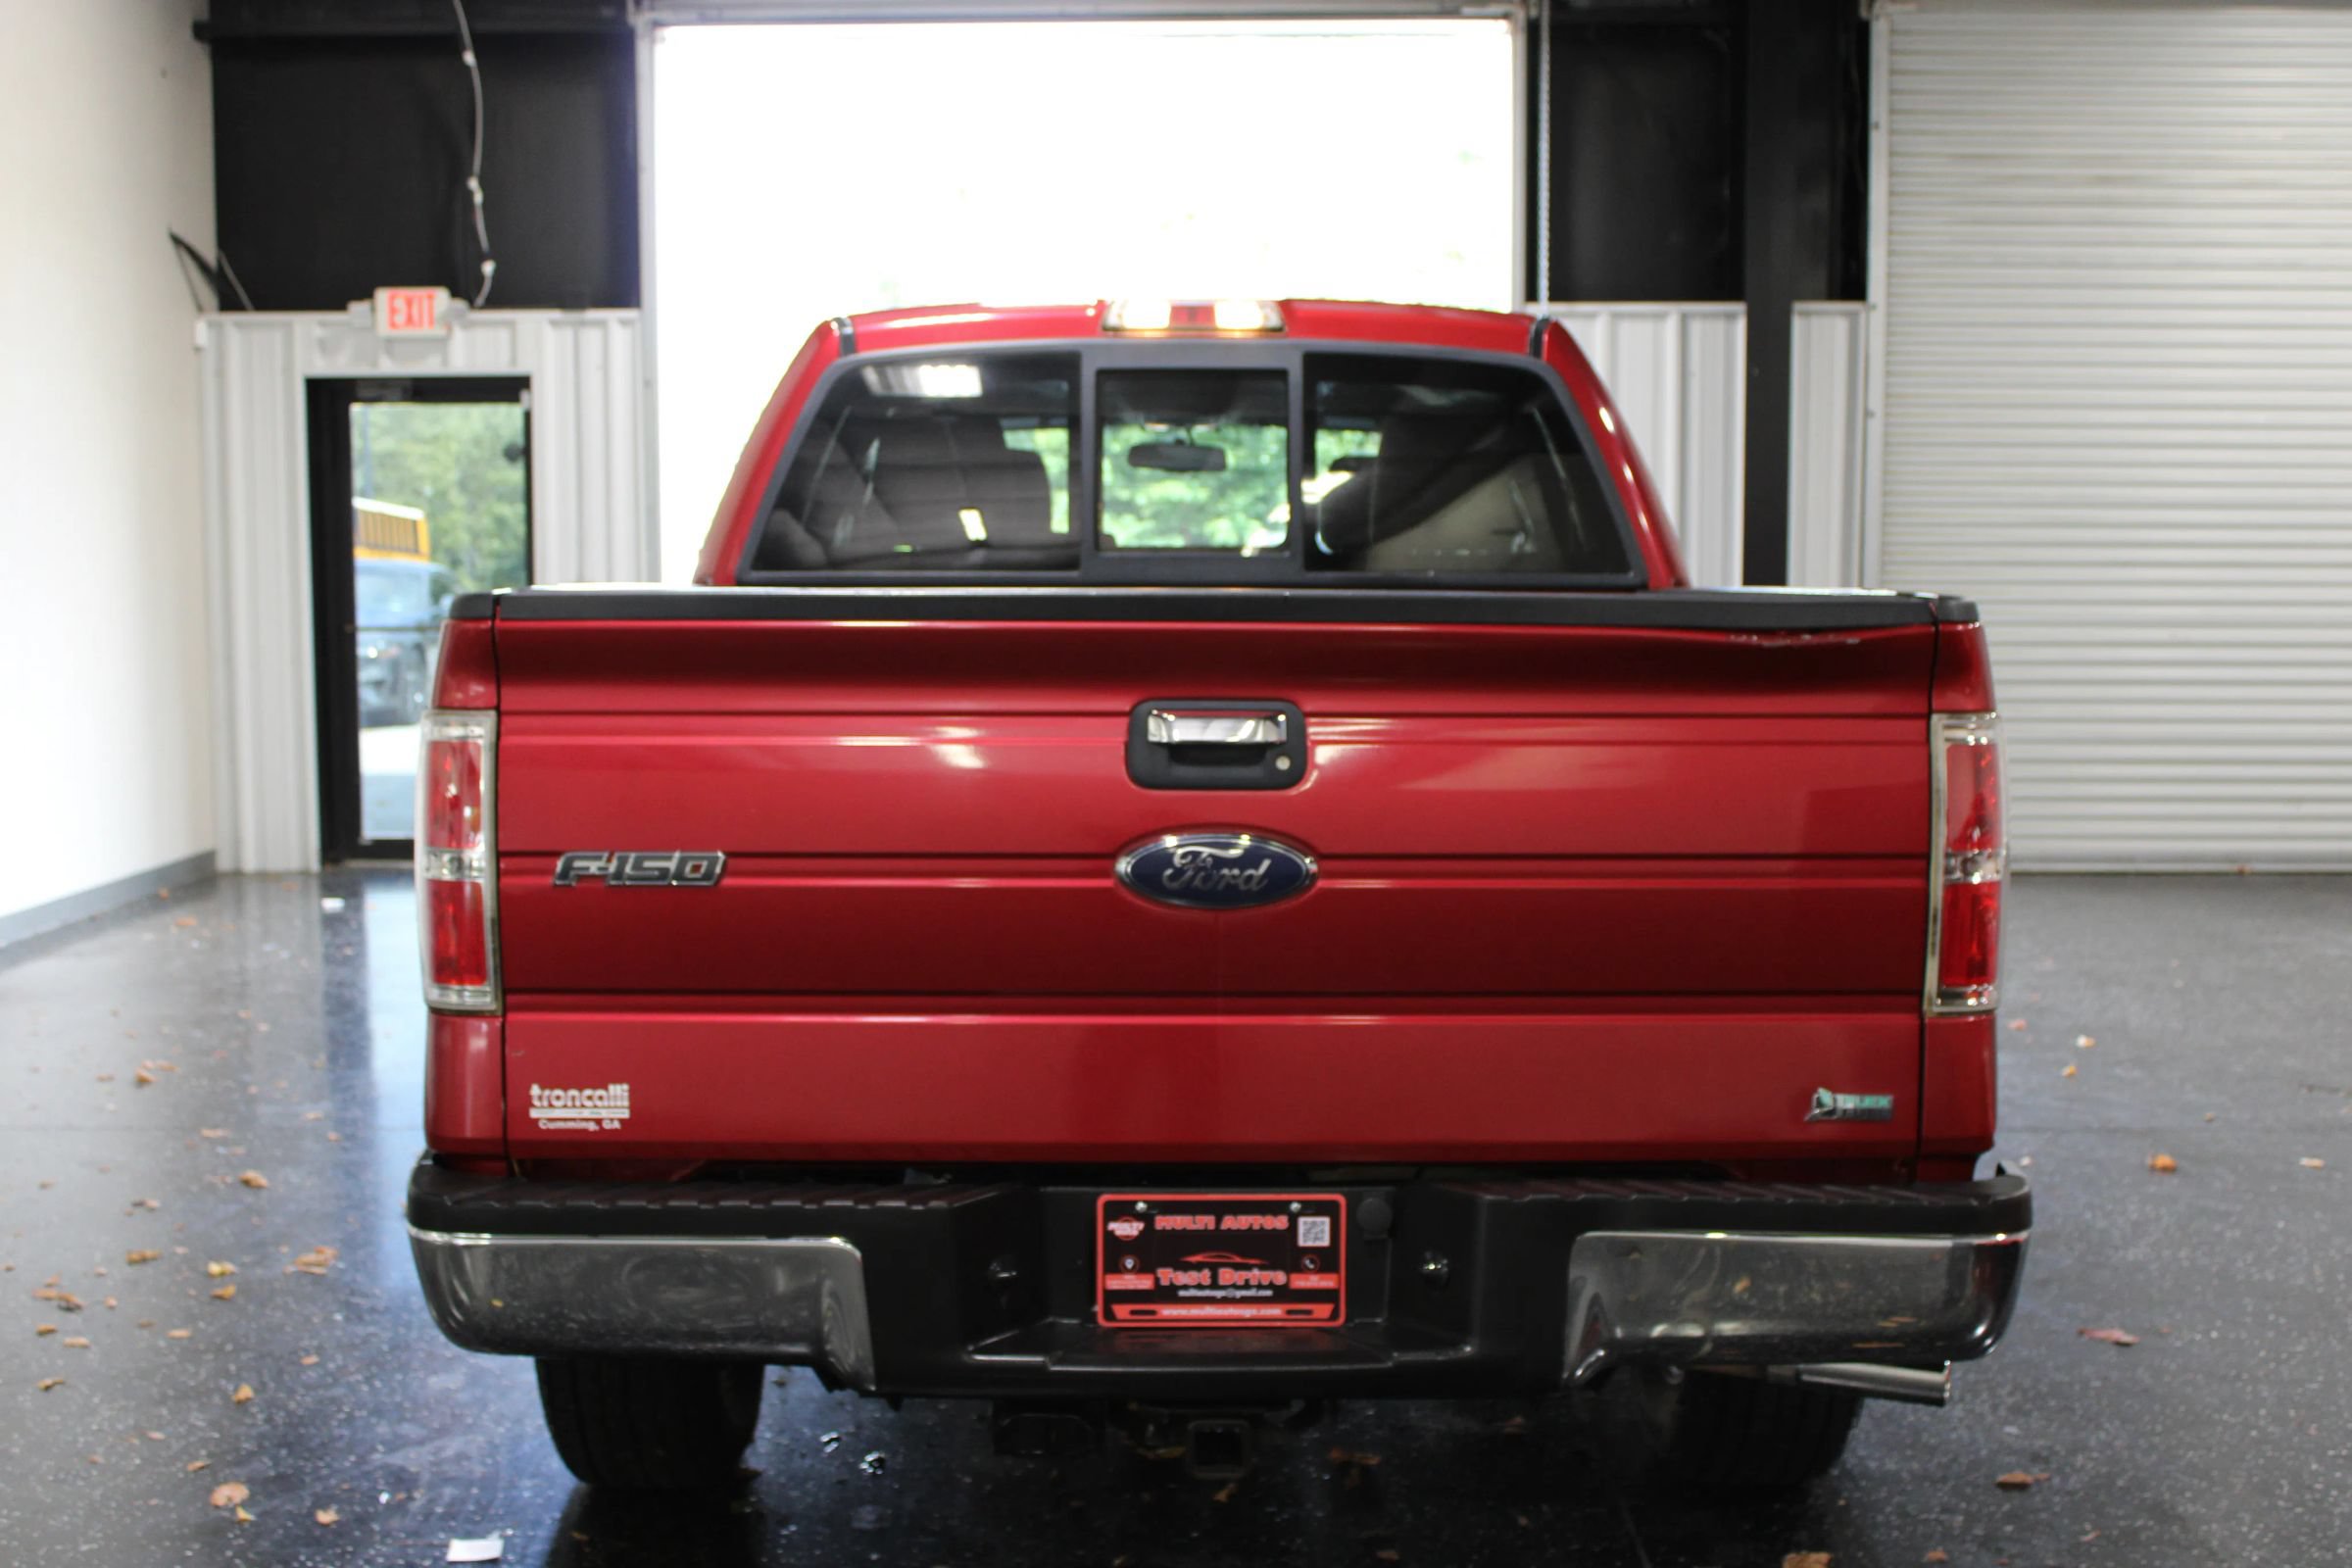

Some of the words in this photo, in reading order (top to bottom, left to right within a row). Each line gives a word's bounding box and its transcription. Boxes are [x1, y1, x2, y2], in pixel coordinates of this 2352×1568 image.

[387, 290, 435, 330] EXIT
[1162, 846, 1272, 893] Ford
[529, 1082, 630, 1108] troncalli
[602, 1119, 621, 1130] GA
[1154, 1215, 1215, 1230] MULTI
[1220, 1215, 1289, 1230] AUTOS
[1156, 1267, 1211, 1286] Test
[1218, 1267, 1288, 1286] Drive
